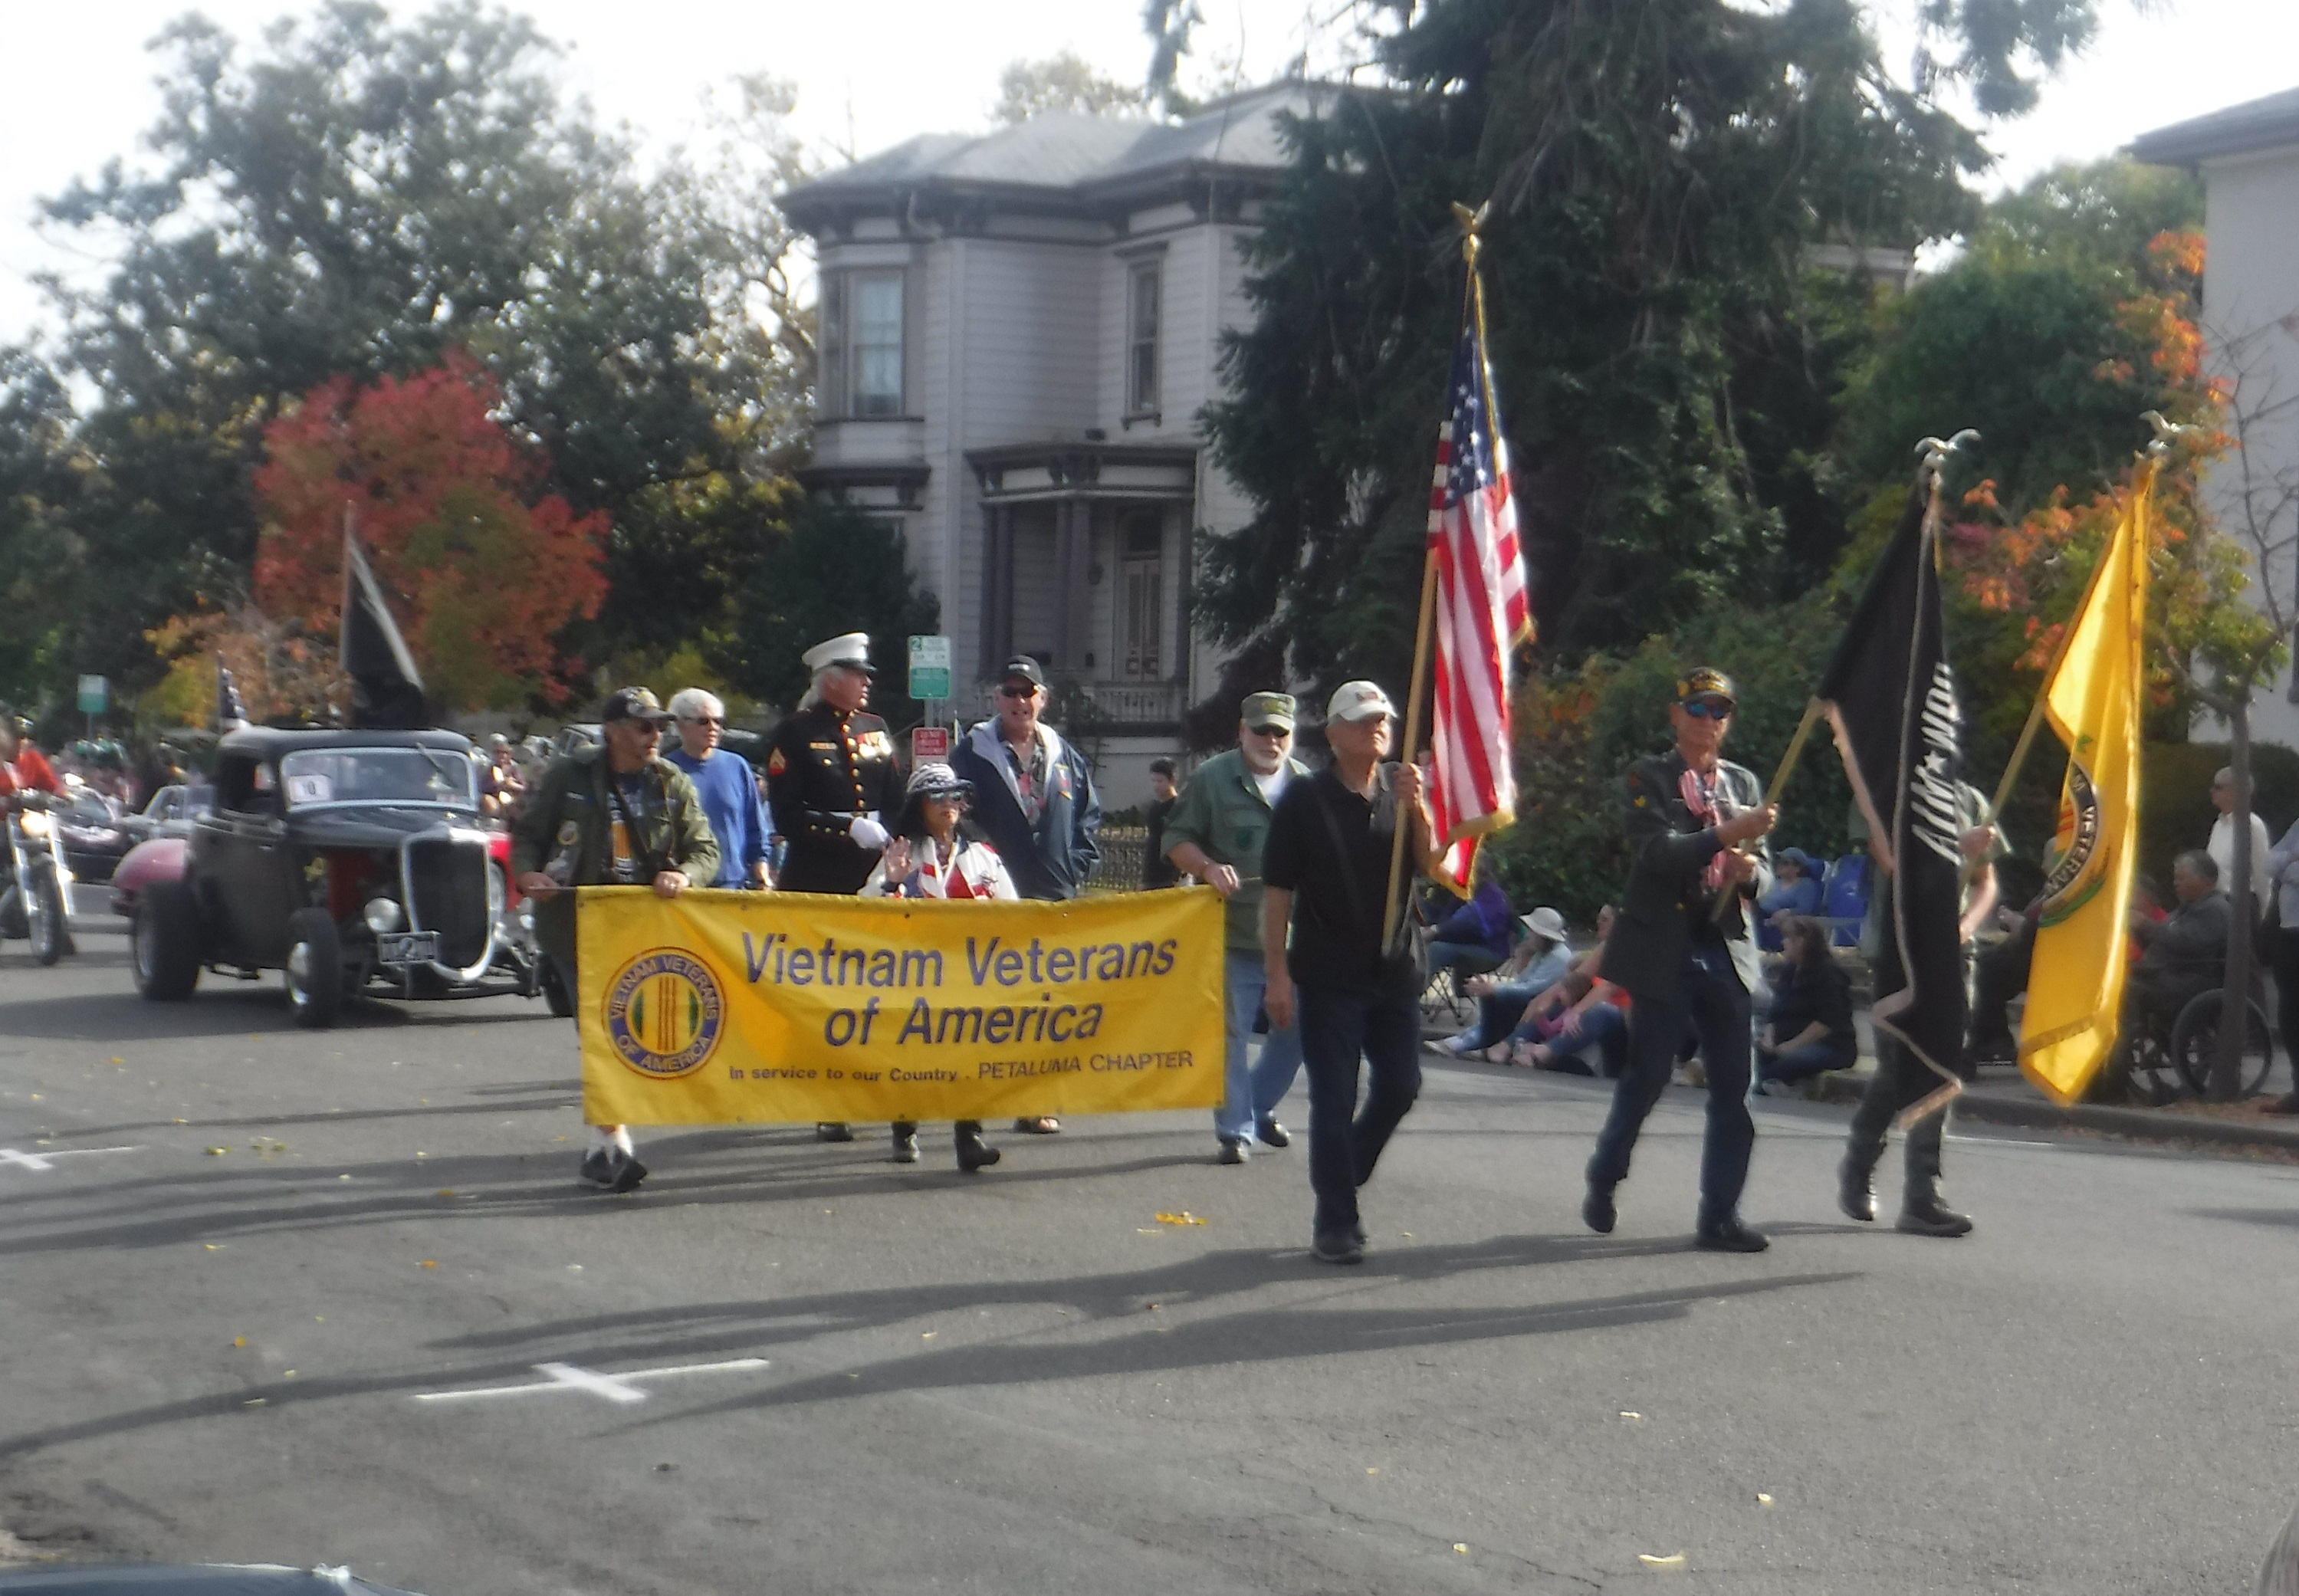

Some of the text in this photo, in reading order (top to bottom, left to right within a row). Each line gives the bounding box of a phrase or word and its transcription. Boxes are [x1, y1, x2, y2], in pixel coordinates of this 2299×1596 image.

[742, 931, 1177, 987] Vietnam Veterans
[610, 956, 719, 1020] VIETNAM VETERANS
[824, 992, 1104, 1046] of America
[616, 1035, 711, 1071] OF AMERICA
[751, 1066, 818, 1080] service
[826, 1069, 844, 1080] to
[852, 1071, 882, 1082] our
[889, 1067, 958, 1083] Country
[977, 1055, 1082, 1079] PETALUMA
[1089, 1049, 1194, 1072] CHAPTER
